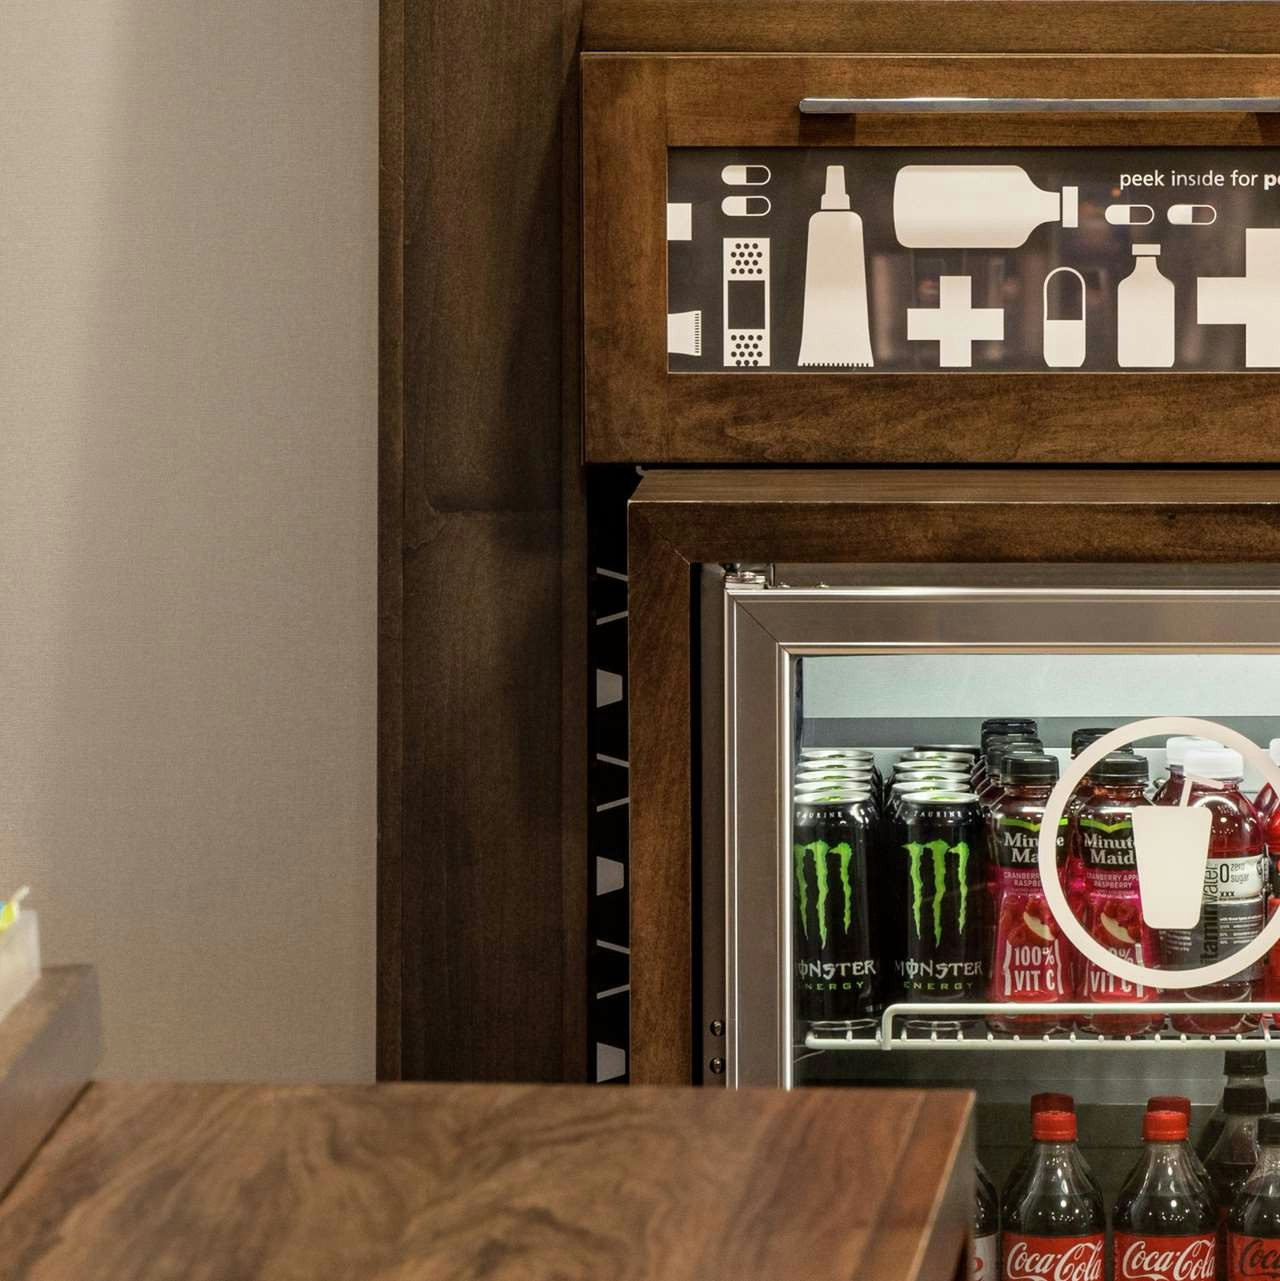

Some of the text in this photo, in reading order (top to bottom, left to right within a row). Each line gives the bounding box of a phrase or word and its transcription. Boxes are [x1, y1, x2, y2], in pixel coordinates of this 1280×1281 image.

[1120, 170, 1165, 189] peek
[1172, 170, 1224, 186] inside
[1230, 170, 1258, 186] for
[1004, 832, 1064, 847] Mine
[1091, 849, 1134, 864] Maid
[1231, 874, 1248, 884] sugar
[1015, 946, 1054, 966] 100%
[895, 958, 983, 979] MONSTER
[904, 981, 973, 990] ENERGY
[1015, 970, 1054, 991] VIT C
[1007, 1241, 1103, 1281] Coca-Cola
[1122, 1240, 1215, 1281] Coca-Cola
